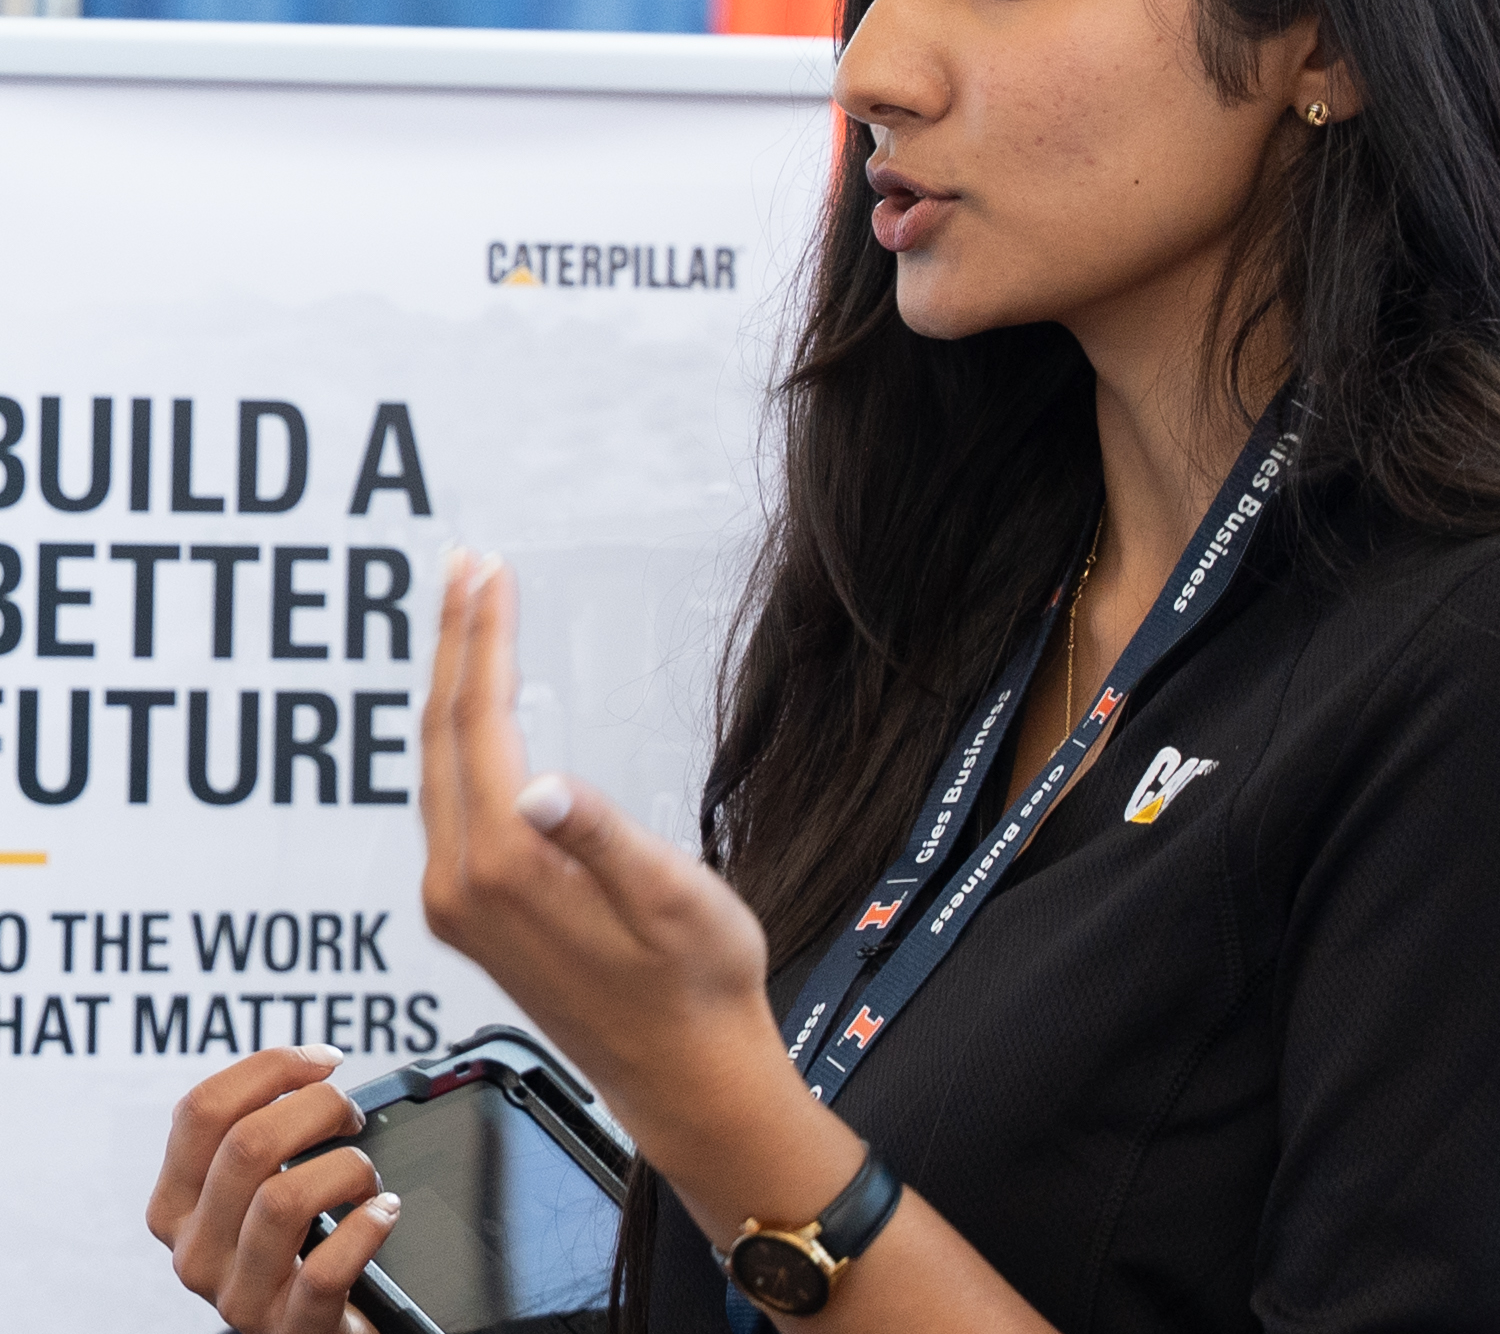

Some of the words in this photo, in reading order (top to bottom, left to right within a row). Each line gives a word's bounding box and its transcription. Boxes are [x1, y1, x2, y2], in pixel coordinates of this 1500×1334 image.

[485, 241, 736, 290] CATERPILLAR
[349, 402, 432, 517] A
[1173, 492, 1263, 615] Business
[915, 809, 952, 865] Gies
[942, 687, 1013, 805] Business
[1020, 763, 1066, 820] Gies
[930, 821, 1022, 936] Business
[51, 912, 170, 975] THE
[191, 912, 389, 975] WORK
[786, 1001, 827, 1066] ness
